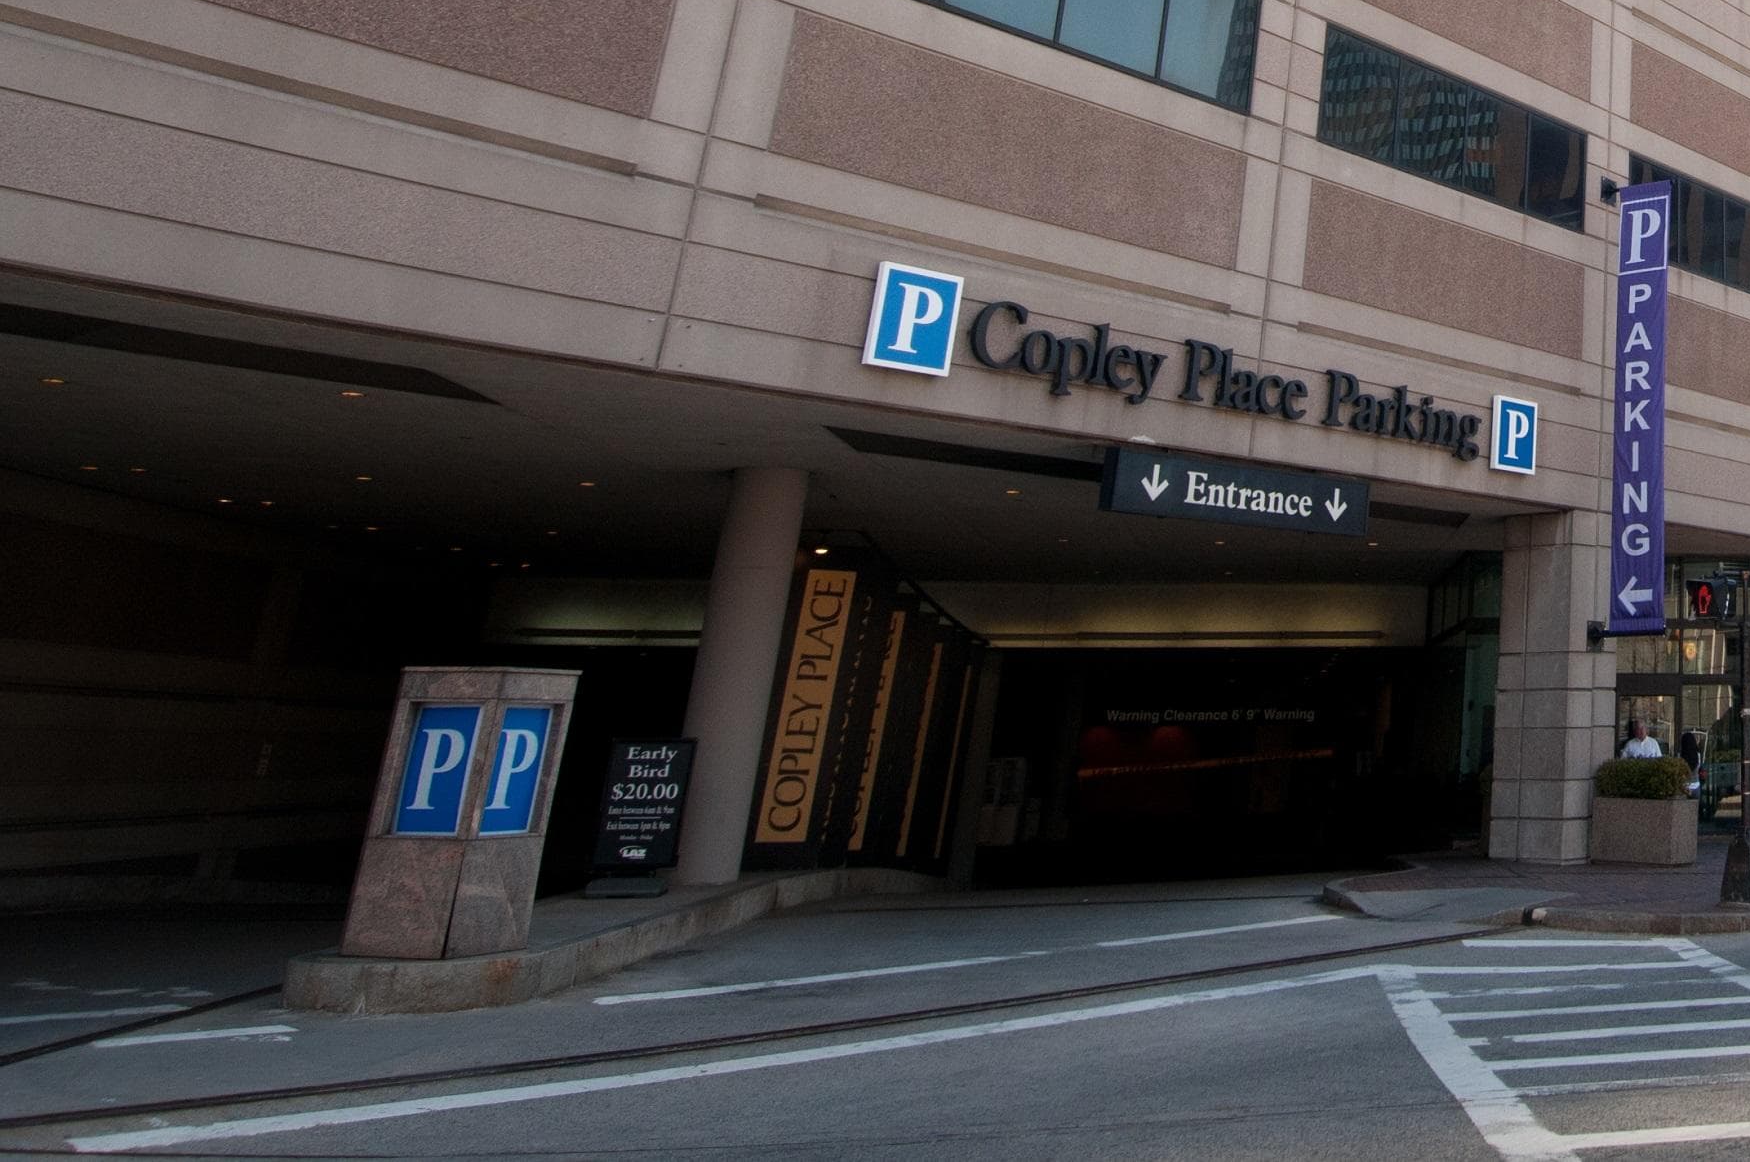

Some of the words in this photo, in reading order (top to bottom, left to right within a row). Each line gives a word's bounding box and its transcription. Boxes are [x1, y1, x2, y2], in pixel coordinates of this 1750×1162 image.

[1623, 207, 1662, 266] P
[887, 282, 944, 354] P
[968, 300, 1168, 406] Copley
[1177, 338, 1309, 420] Place
[1320, 368, 1483, 462] Parking
[1503, 408, 1529, 461] P
[1620, 282, 1652, 558] PARKING
[1183, 470, 1313, 517] Entrance
[767, 694, 823, 833] COPLEY
[796, 578, 848, 681] PLACE
[1106, 709, 1160, 723] Warning
[1163, 709, 1229, 722] Clearance
[1264, 709, 1316, 723] Warning
[405, 728, 466, 810] P
[484, 728, 539, 810] P
[626, 745, 678, 763] Early
[627, 764, 670, 778] Bird
[611, 782, 679, 801] $20.00
[622, 848, 648, 858] LAZ
